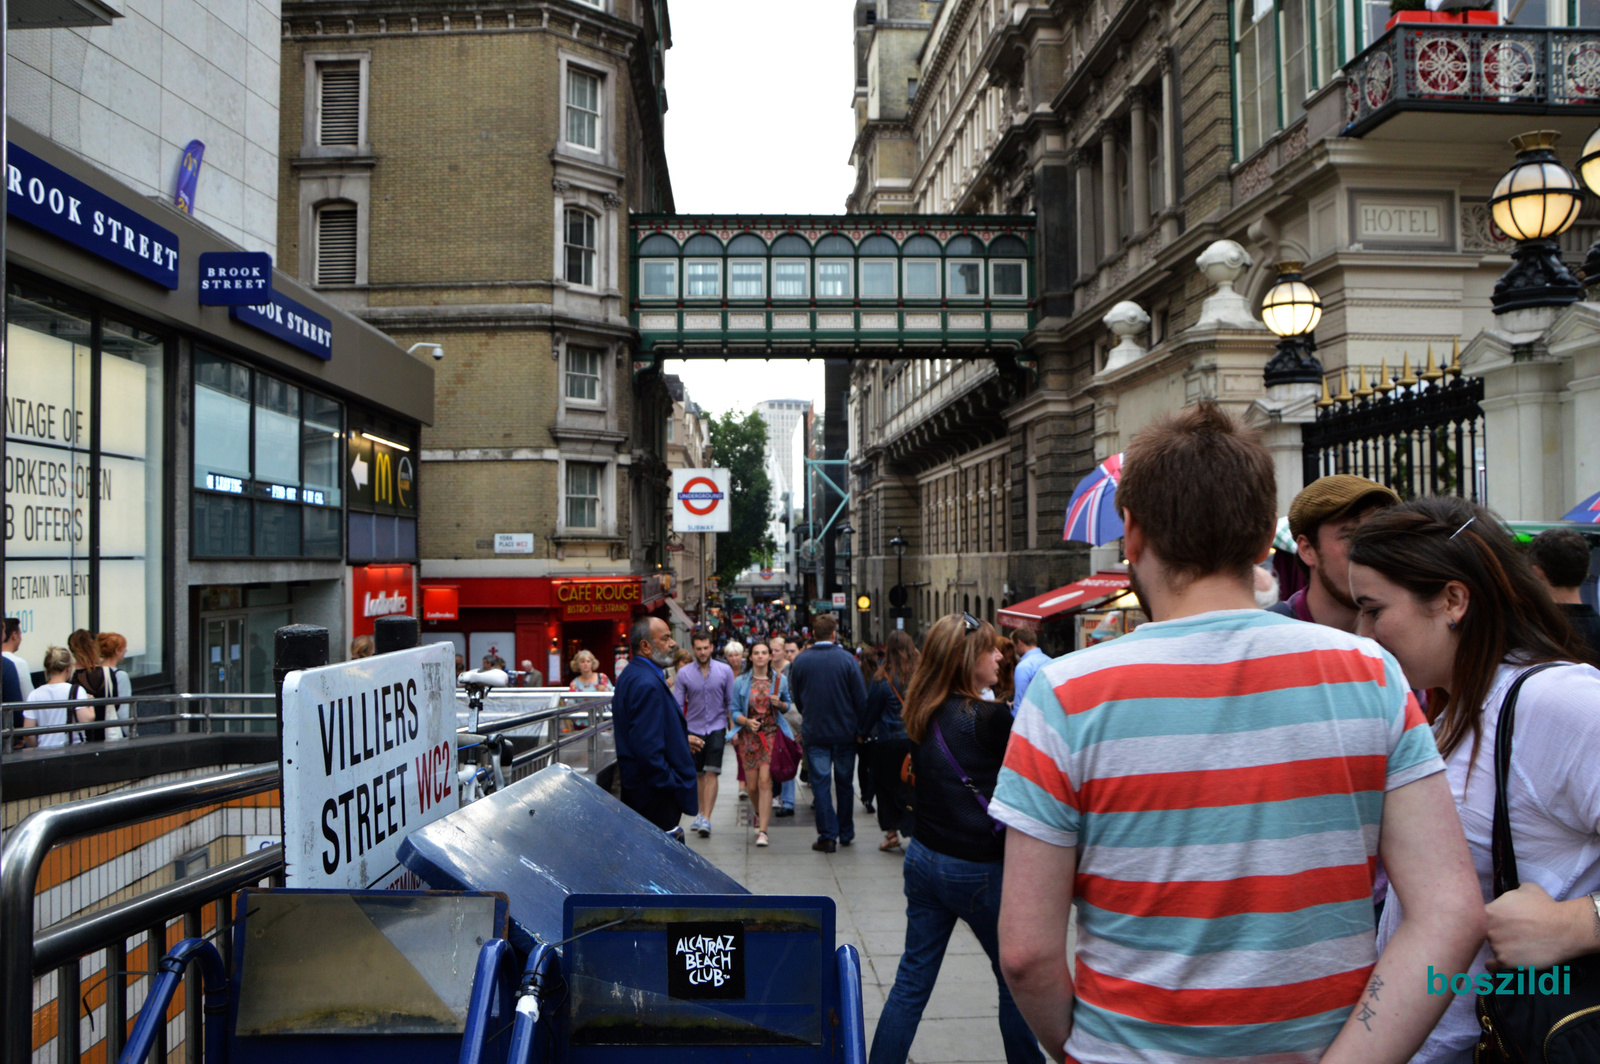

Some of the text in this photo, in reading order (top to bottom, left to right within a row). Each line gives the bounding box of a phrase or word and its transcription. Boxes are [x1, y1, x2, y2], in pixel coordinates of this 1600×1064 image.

[1364, 209, 1436, 233] HOTEL
[93, 210, 178, 271] STREET
[202, 279, 265, 289] STREET
[207, 267, 260, 277] BROOK
[287, 311, 332, 347] STREET
[63, 408, 83, 443] OF
[24, 505, 83, 542] OFFERS
[11, 575, 50, 600] RETAIN
[595, 584, 640, 601] ROUGE
[567, 603, 629, 614] BISTRO THE STRAND
[317, 678, 419, 777] VILLIERS
[321, 740, 452, 876] STREET WC2
[675, 934, 736, 957] ALCATRAZ
[685, 951, 732, 970] BEACH
